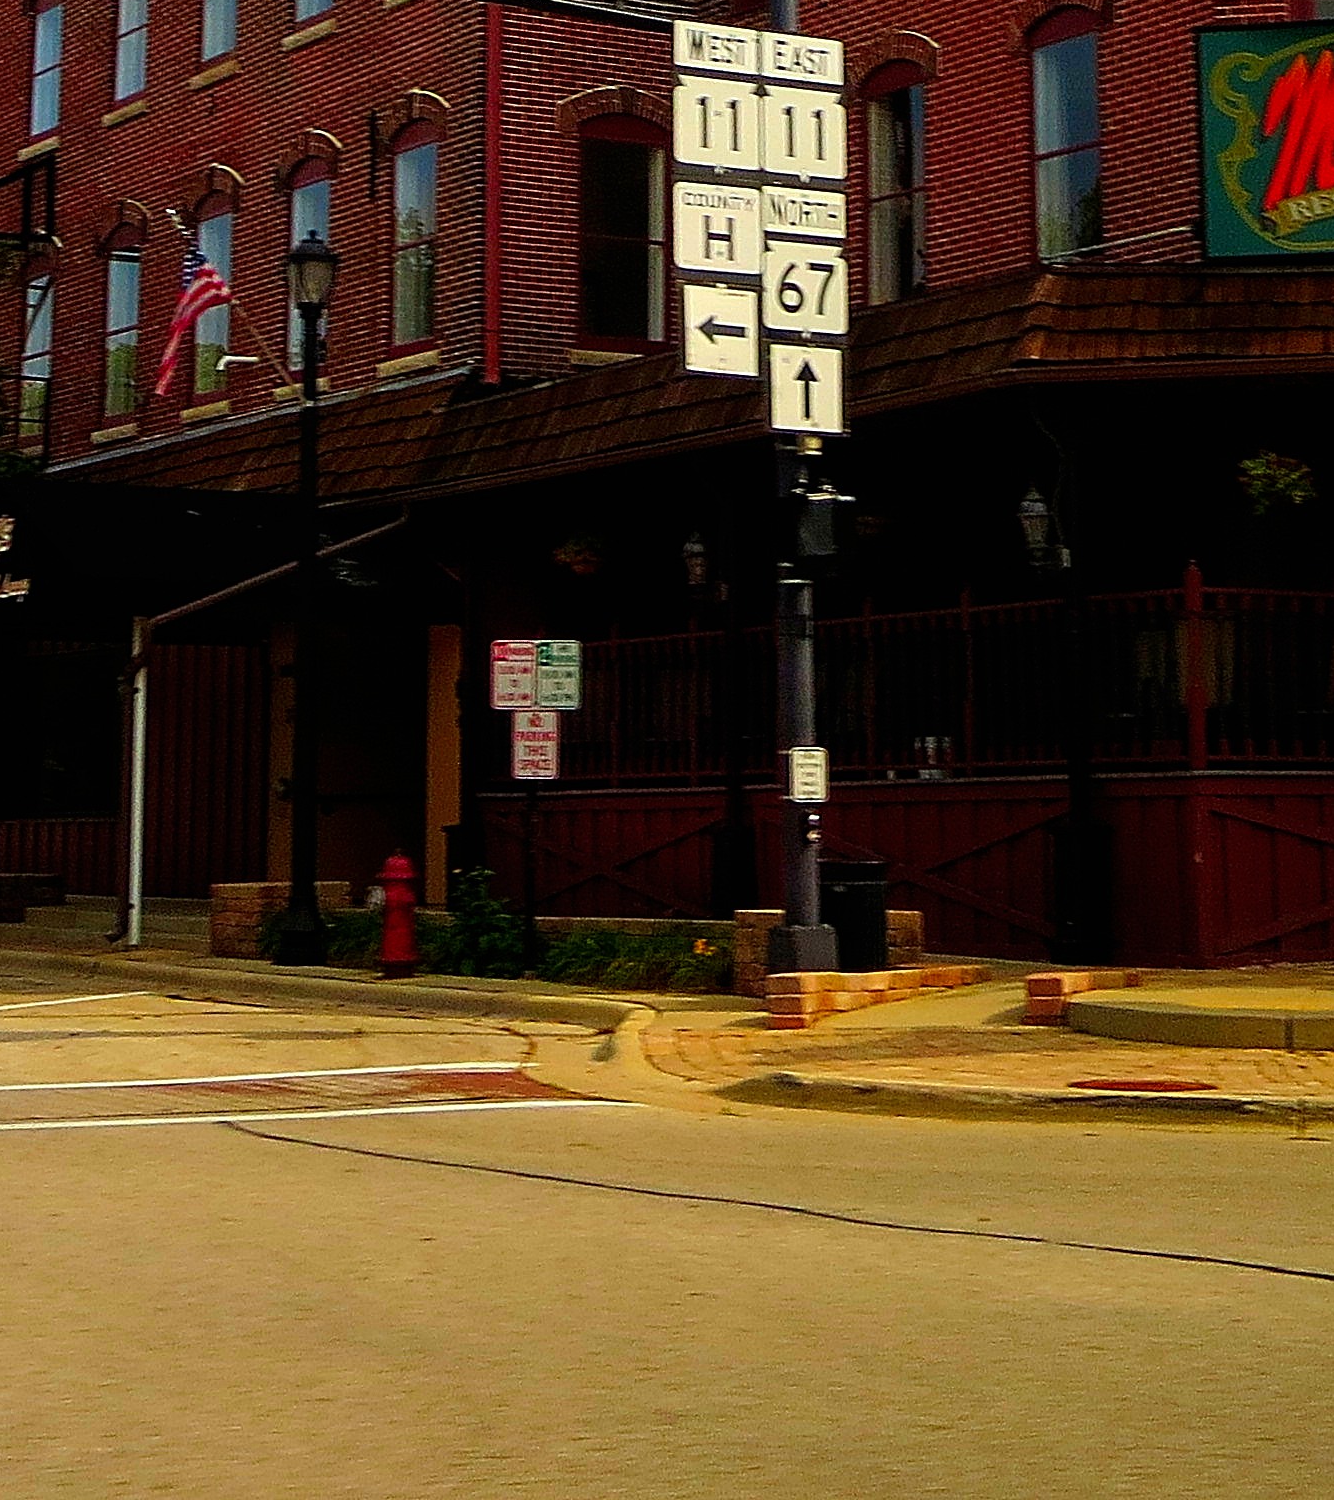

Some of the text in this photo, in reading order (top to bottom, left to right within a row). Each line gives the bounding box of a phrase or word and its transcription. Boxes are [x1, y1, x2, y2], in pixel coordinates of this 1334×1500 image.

[686, 30, 748, 66] WEST
[774, 39, 832, 75] EAST
[697, 95, 742, 153] 11
[782, 105, 827, 161] 11
[683, 192, 755, 212] COUNTY
[767, 192, 841, 229] NORTH
[703, 214, 736, 262] H
[777, 261, 835, 318] 67
